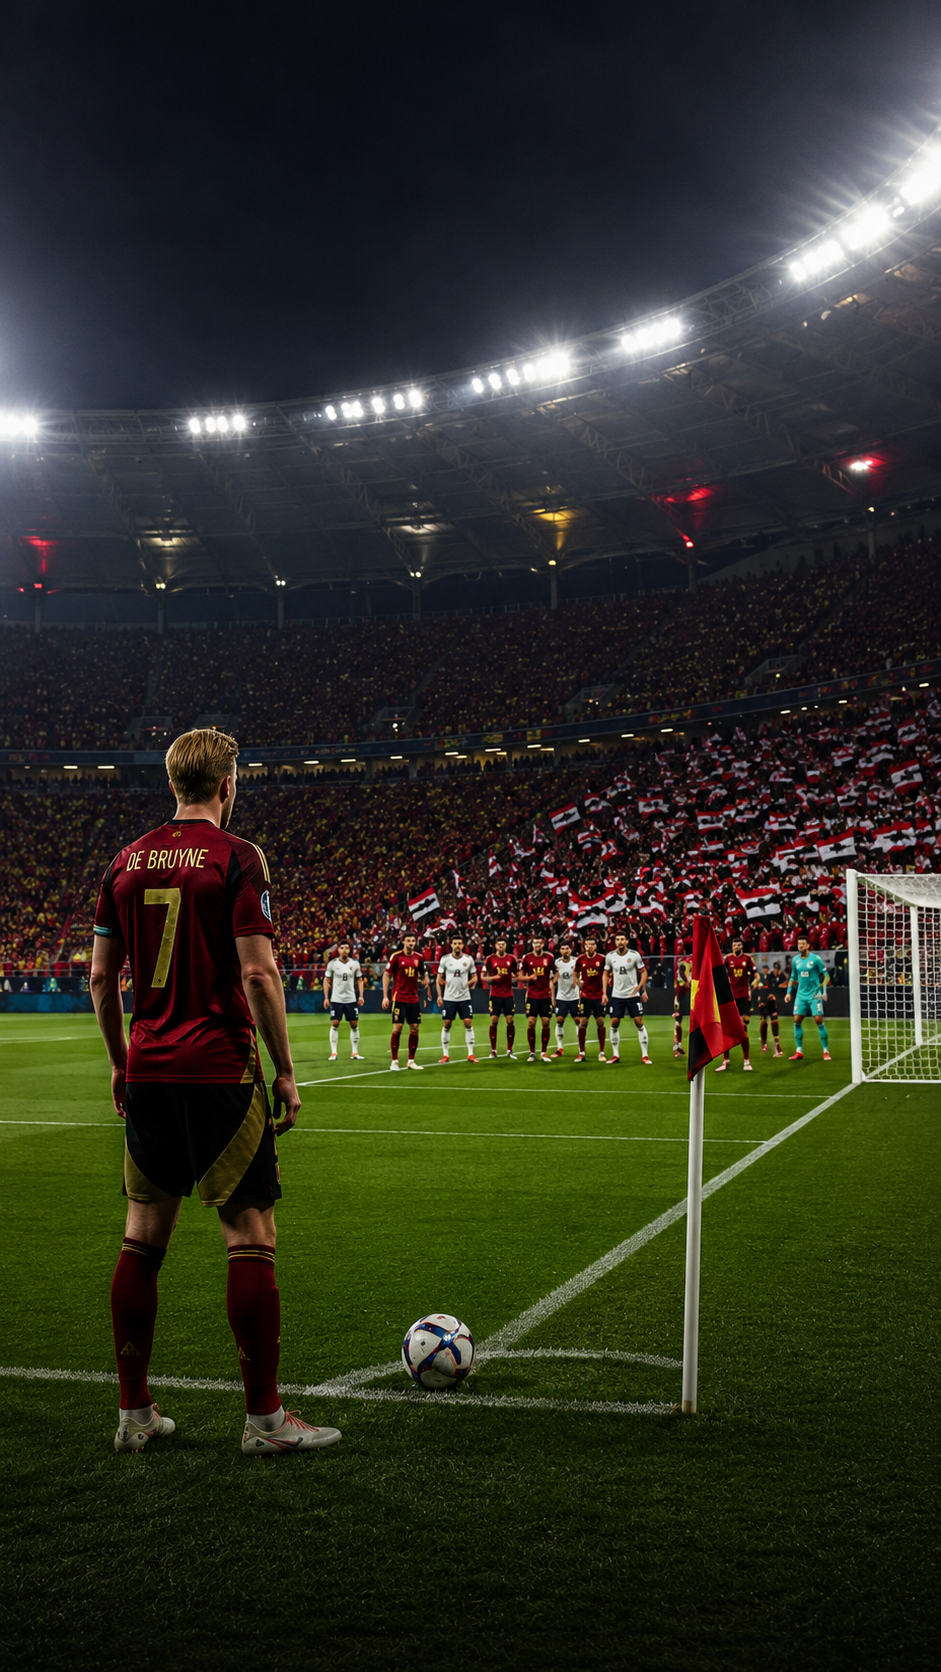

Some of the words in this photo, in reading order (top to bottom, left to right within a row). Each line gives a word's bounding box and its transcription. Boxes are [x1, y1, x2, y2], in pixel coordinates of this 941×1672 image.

[126, 850, 145, 872] DE
[146, 848, 209, 870] BRUYNE
[144, 888, 181, 988] 7
